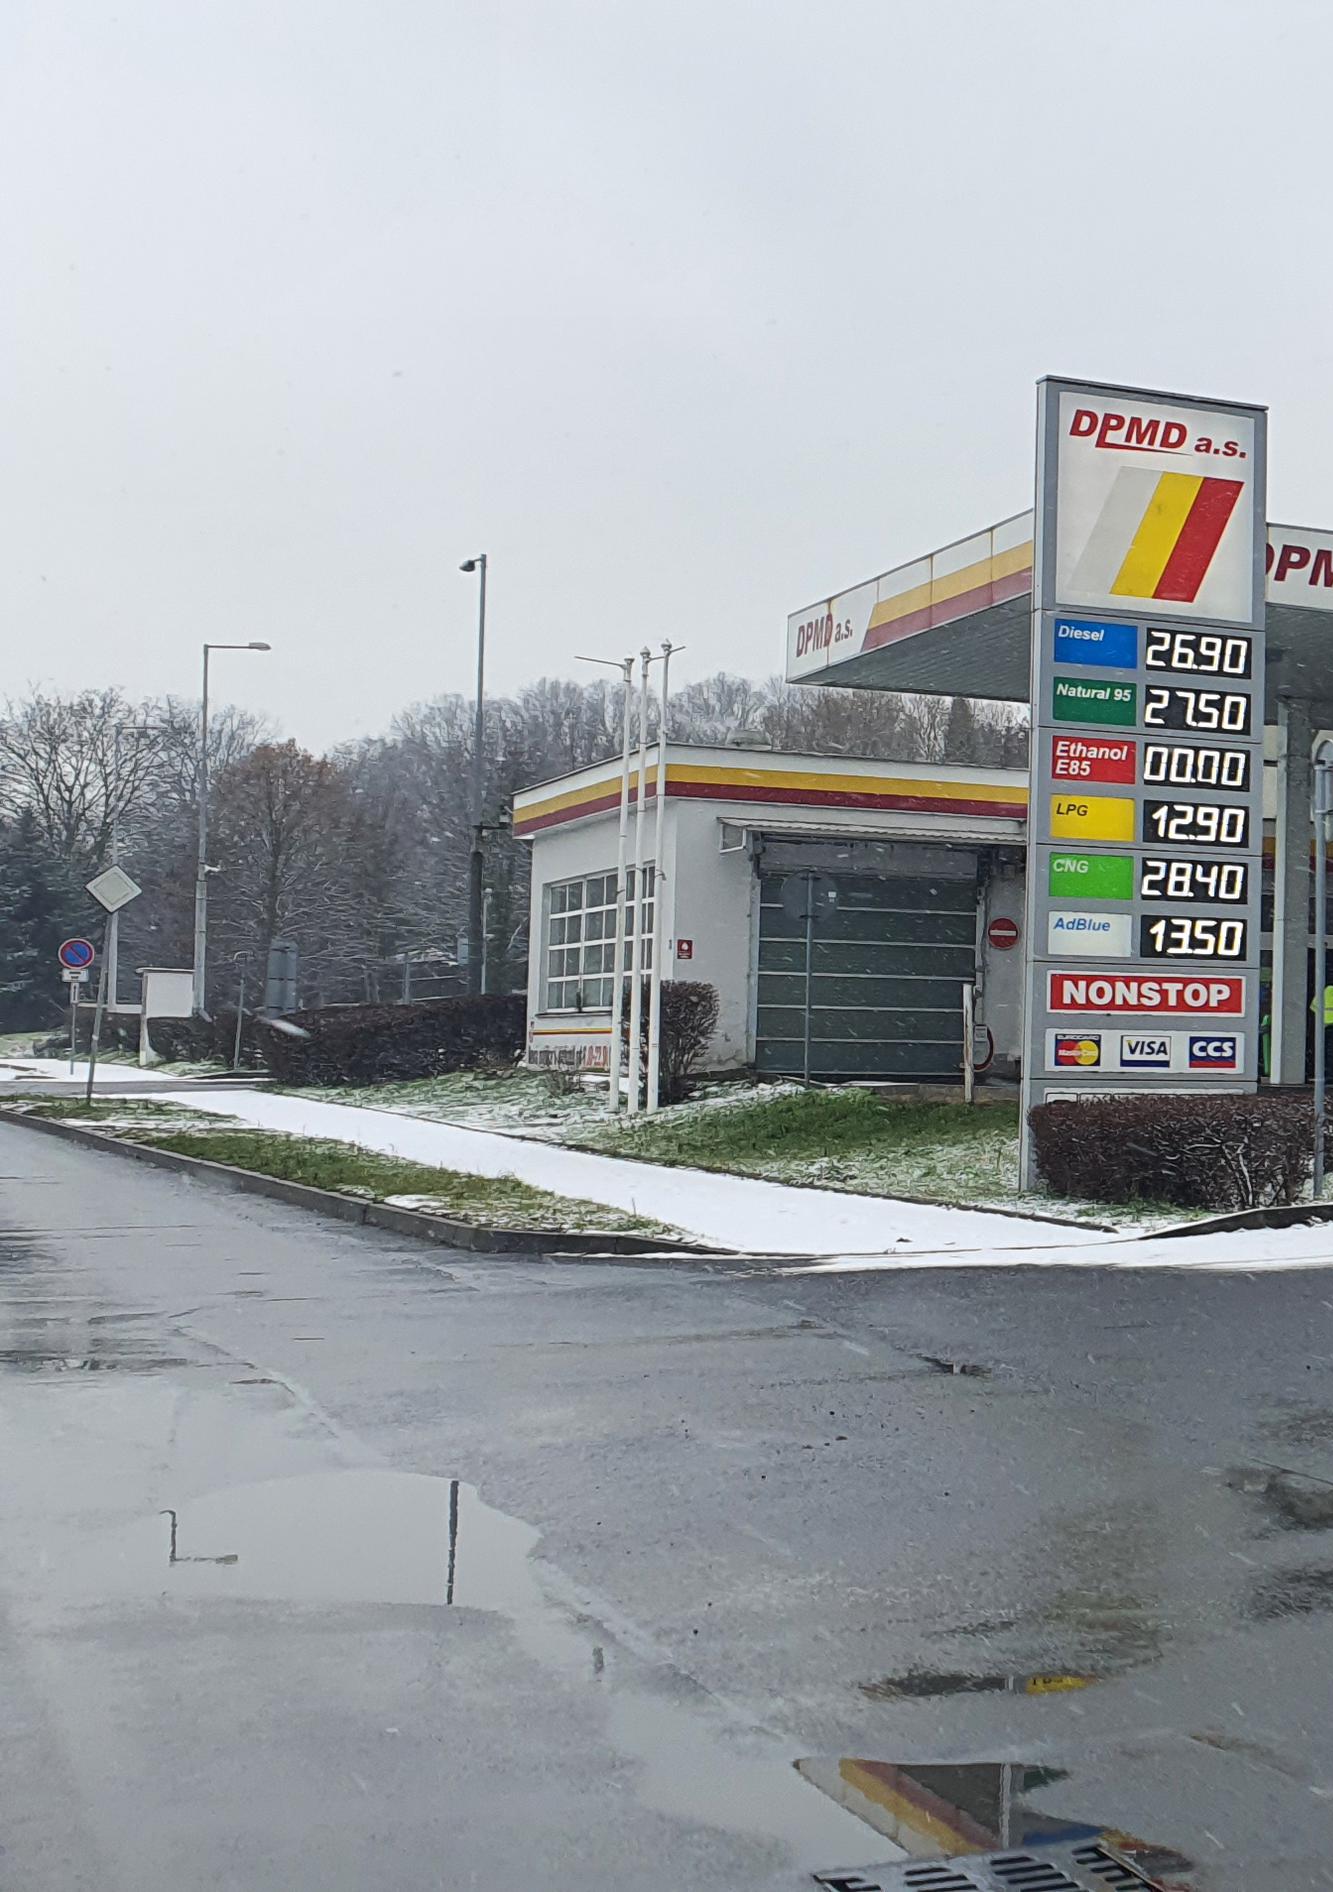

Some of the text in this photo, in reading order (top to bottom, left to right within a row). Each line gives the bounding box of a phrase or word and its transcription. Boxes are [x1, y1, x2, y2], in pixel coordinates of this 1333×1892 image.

[1069, 409, 1248, 459] DPMD a.s.
[796, 612, 853, 658] DPMD a.s.
[1058, 625, 1104, 644] Diesel
[1146, 631, 1248, 674] 26.90
[1056, 683, 1132, 702] Natural 95
[1144, 689, 1247, 730] 27.50
[1055, 740, 1128, 761] Ethanol
[1055, 759, 1091, 776] E85
[1143, 746, 1246, 787] 00.00
[1056, 803, 1088, 817] LPG
[1152, 804, 1246, 844] 12.90
[1053, 859, 1089, 873] CNG
[1141, 861, 1245, 900] 28.40
[1053, 917, 1110, 932] AdBlue
[1149, 918, 1244, 956] 13.50
[1062, 979, 1231, 1008] NONSTOP
[1126, 1039, 1168, 1057] VISA
[1191, 1041, 1234, 1058] CCS
